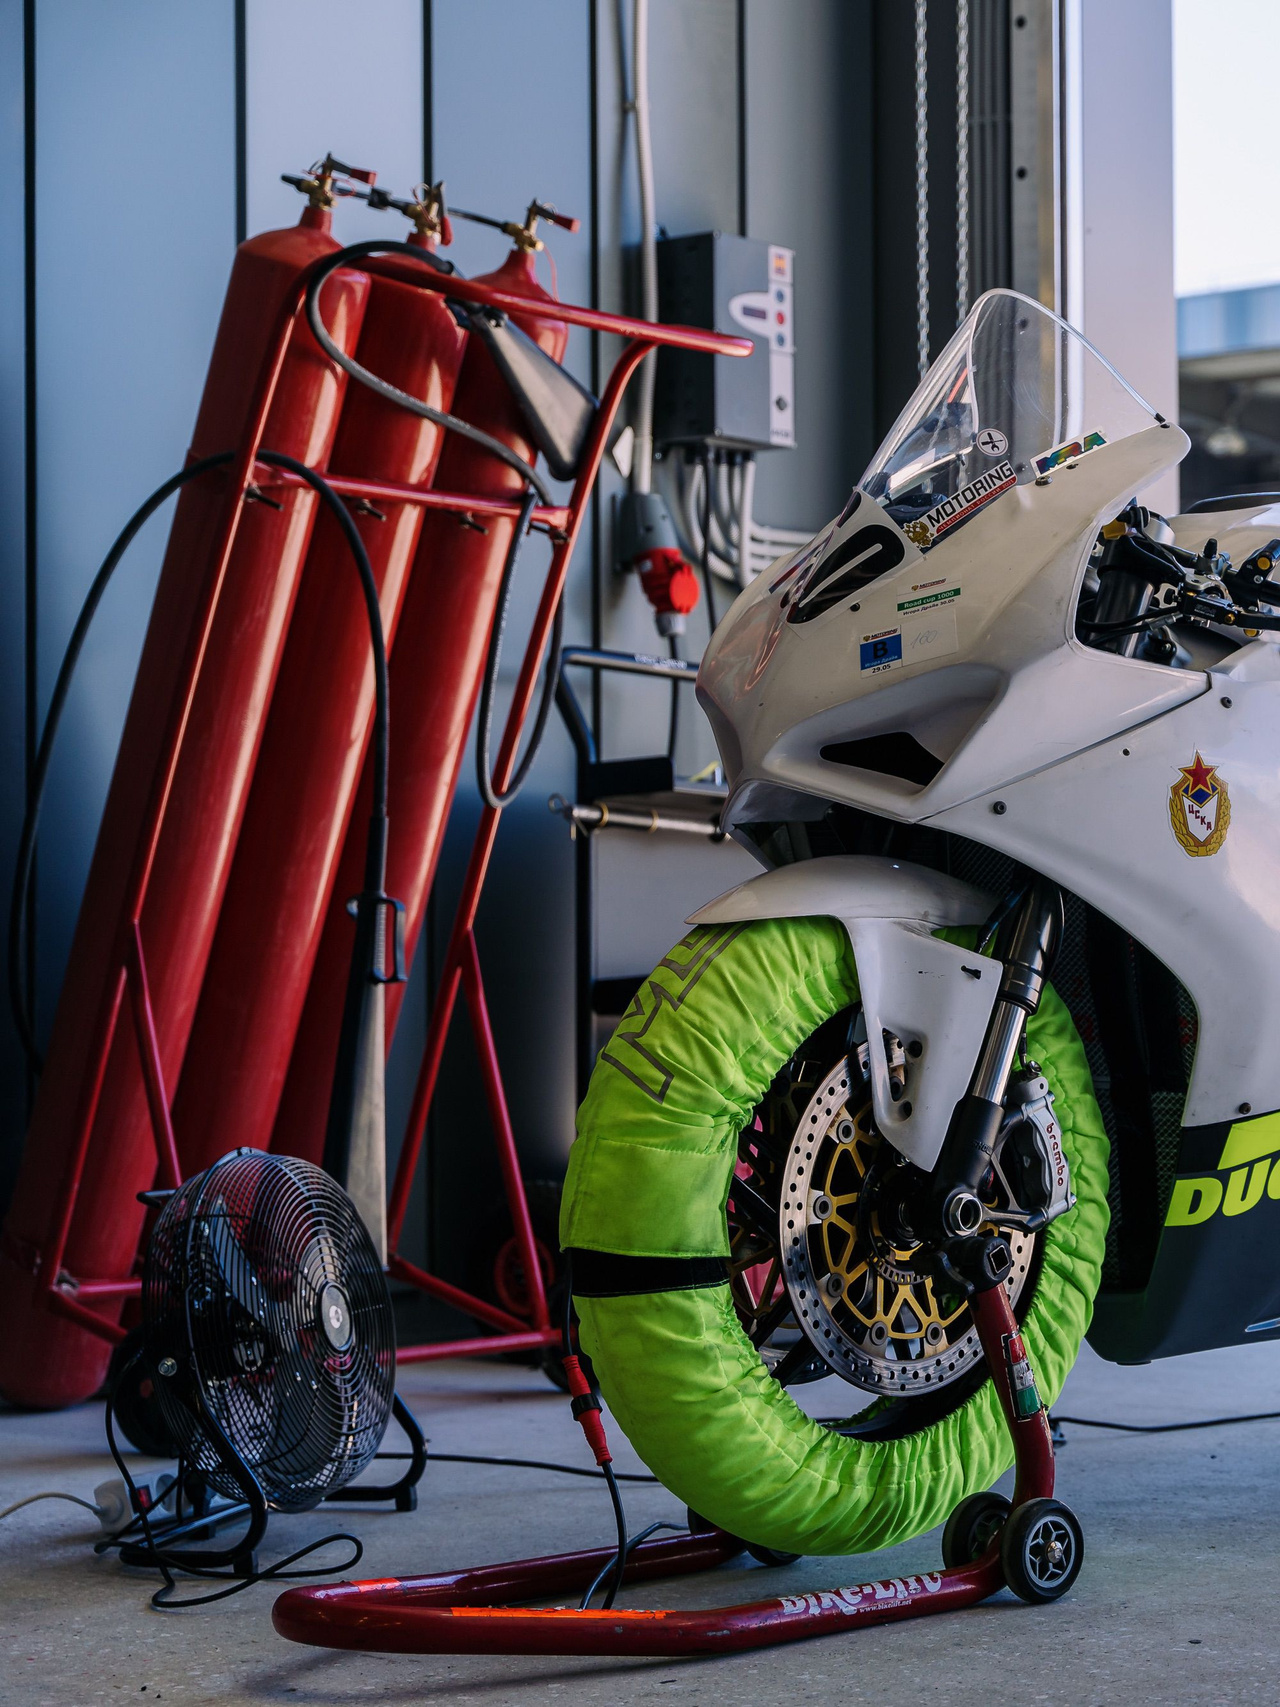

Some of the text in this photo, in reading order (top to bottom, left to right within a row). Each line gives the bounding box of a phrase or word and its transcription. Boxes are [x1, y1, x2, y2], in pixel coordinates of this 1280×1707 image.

[926, 461, 1015, 528] MOTORING
[938, 504, 975, 531] ЧЕМПИОНАТ
[977, 487, 1001, 505] РОССИИ
[904, 590, 955, 609] Road cup 1000
[872, 663, 891, 674] 29.05
[1188, 804, 1212, 831] ЦСКА
[1046, 1122, 1065, 1187] brembo
